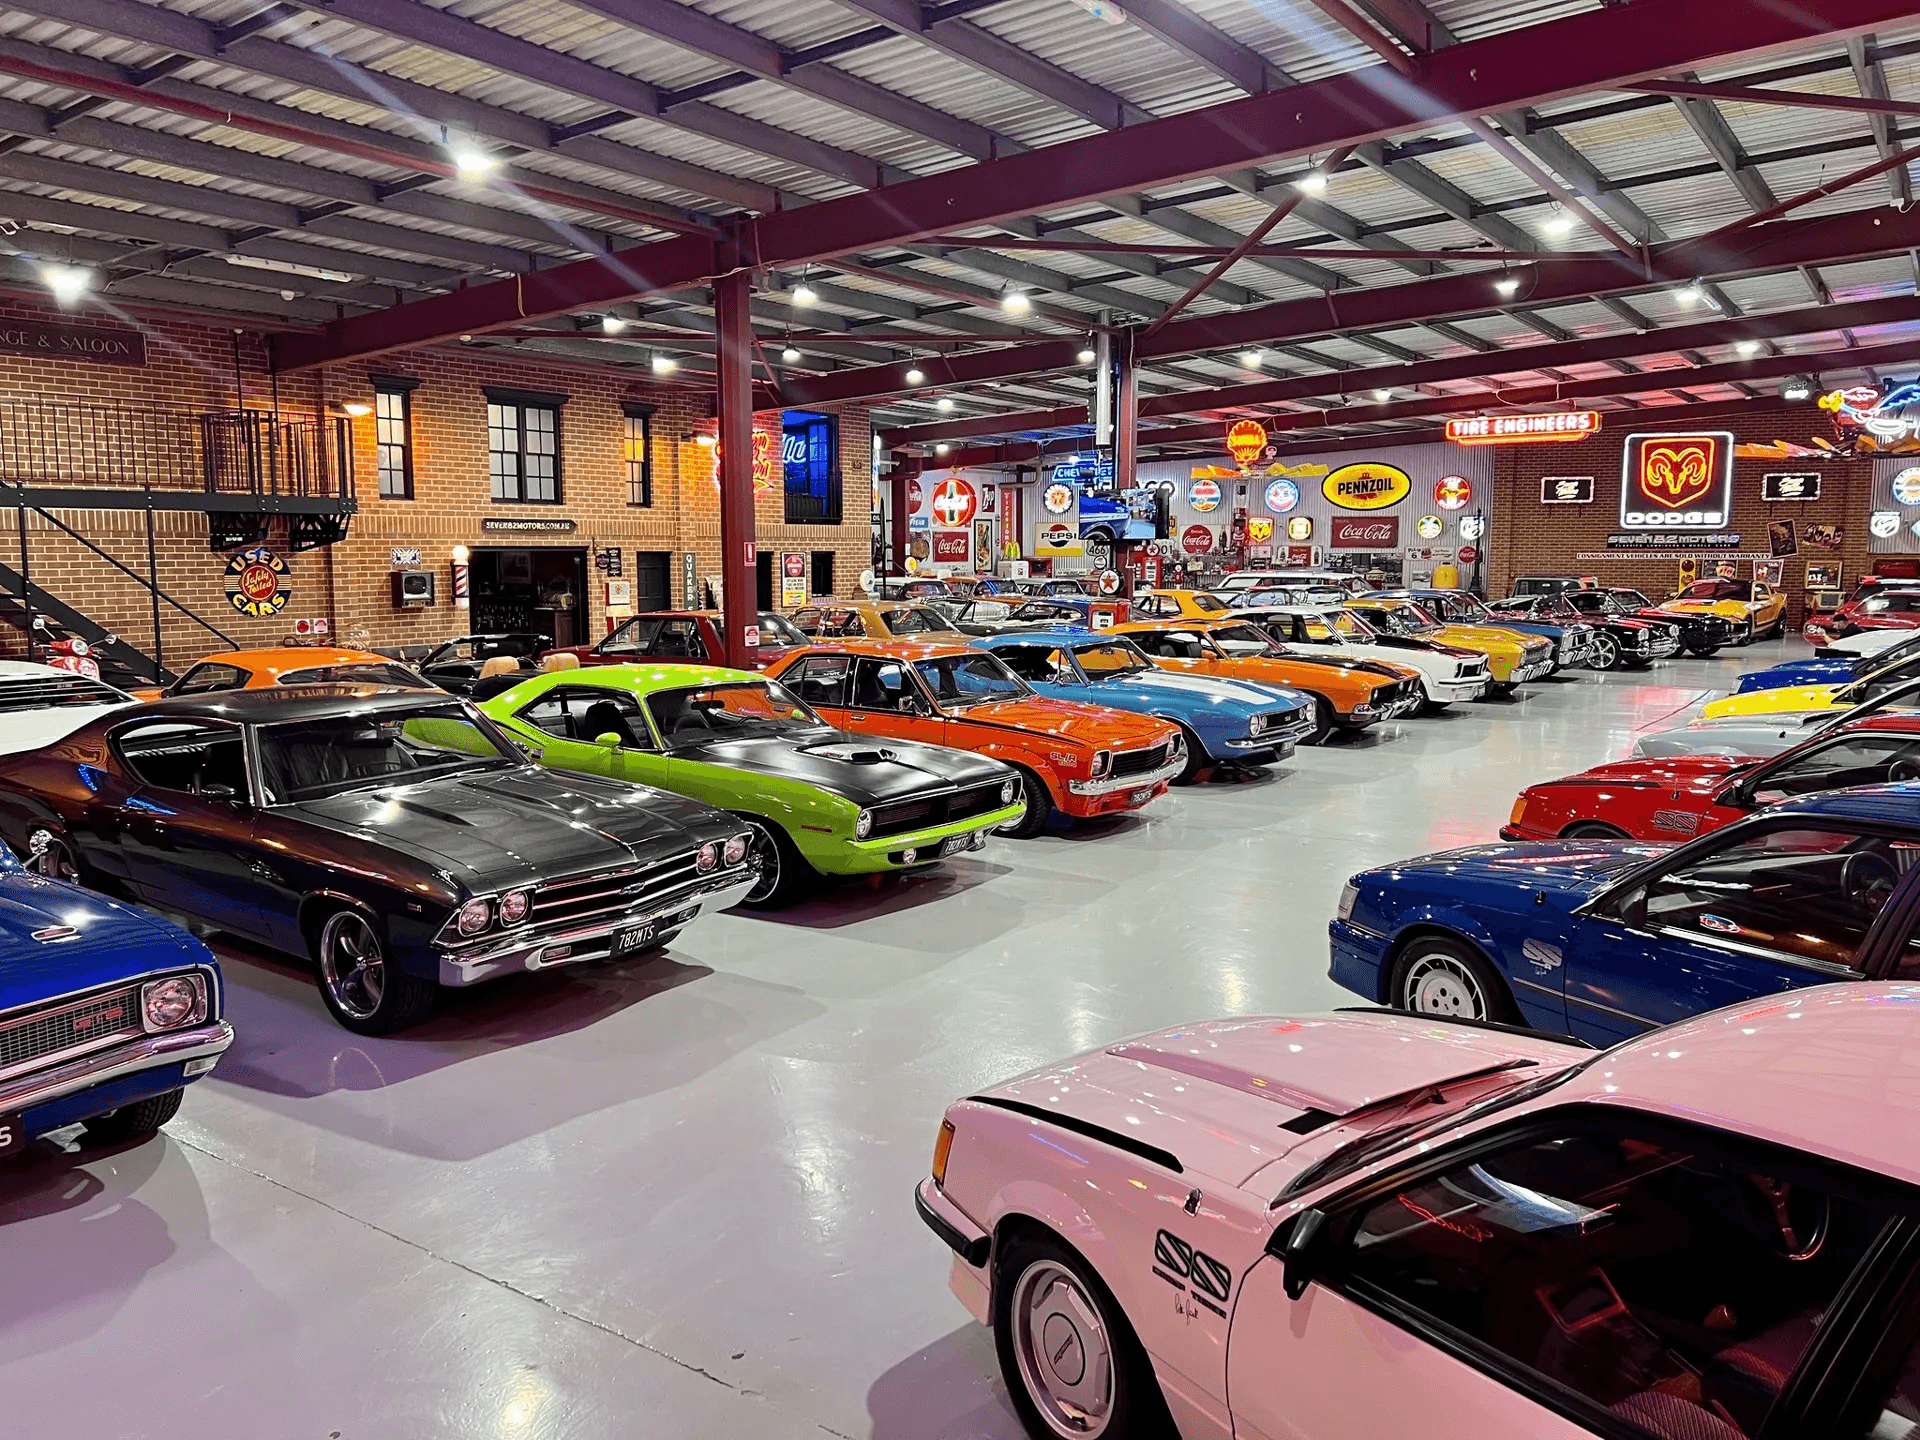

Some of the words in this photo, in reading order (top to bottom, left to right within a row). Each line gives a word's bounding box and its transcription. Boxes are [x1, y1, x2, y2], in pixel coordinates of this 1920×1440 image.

[38, 334, 52, 348] &
[59, 335, 129, 354] SALOON
[1453, 421, 1488, 436] TIRE
[1495, 414, 1590, 433] ENGINEERS
[1338, 478, 1395, 496] PENNZOIL
[1626, 512, 1723, 525] DODGE
[1041, 532, 1077, 540] PEPSI
[1608, 533, 1653, 544] SEVEN
[1653, 534, 1679, 544] 82
[1678, 534, 1740, 544] MOTORS
[231, 549, 284, 572] USED
[685, 554, 694, 602] QUAKER
[232, 593, 285, 617] CARS
[618, 924, 655, 950] 782MTS
